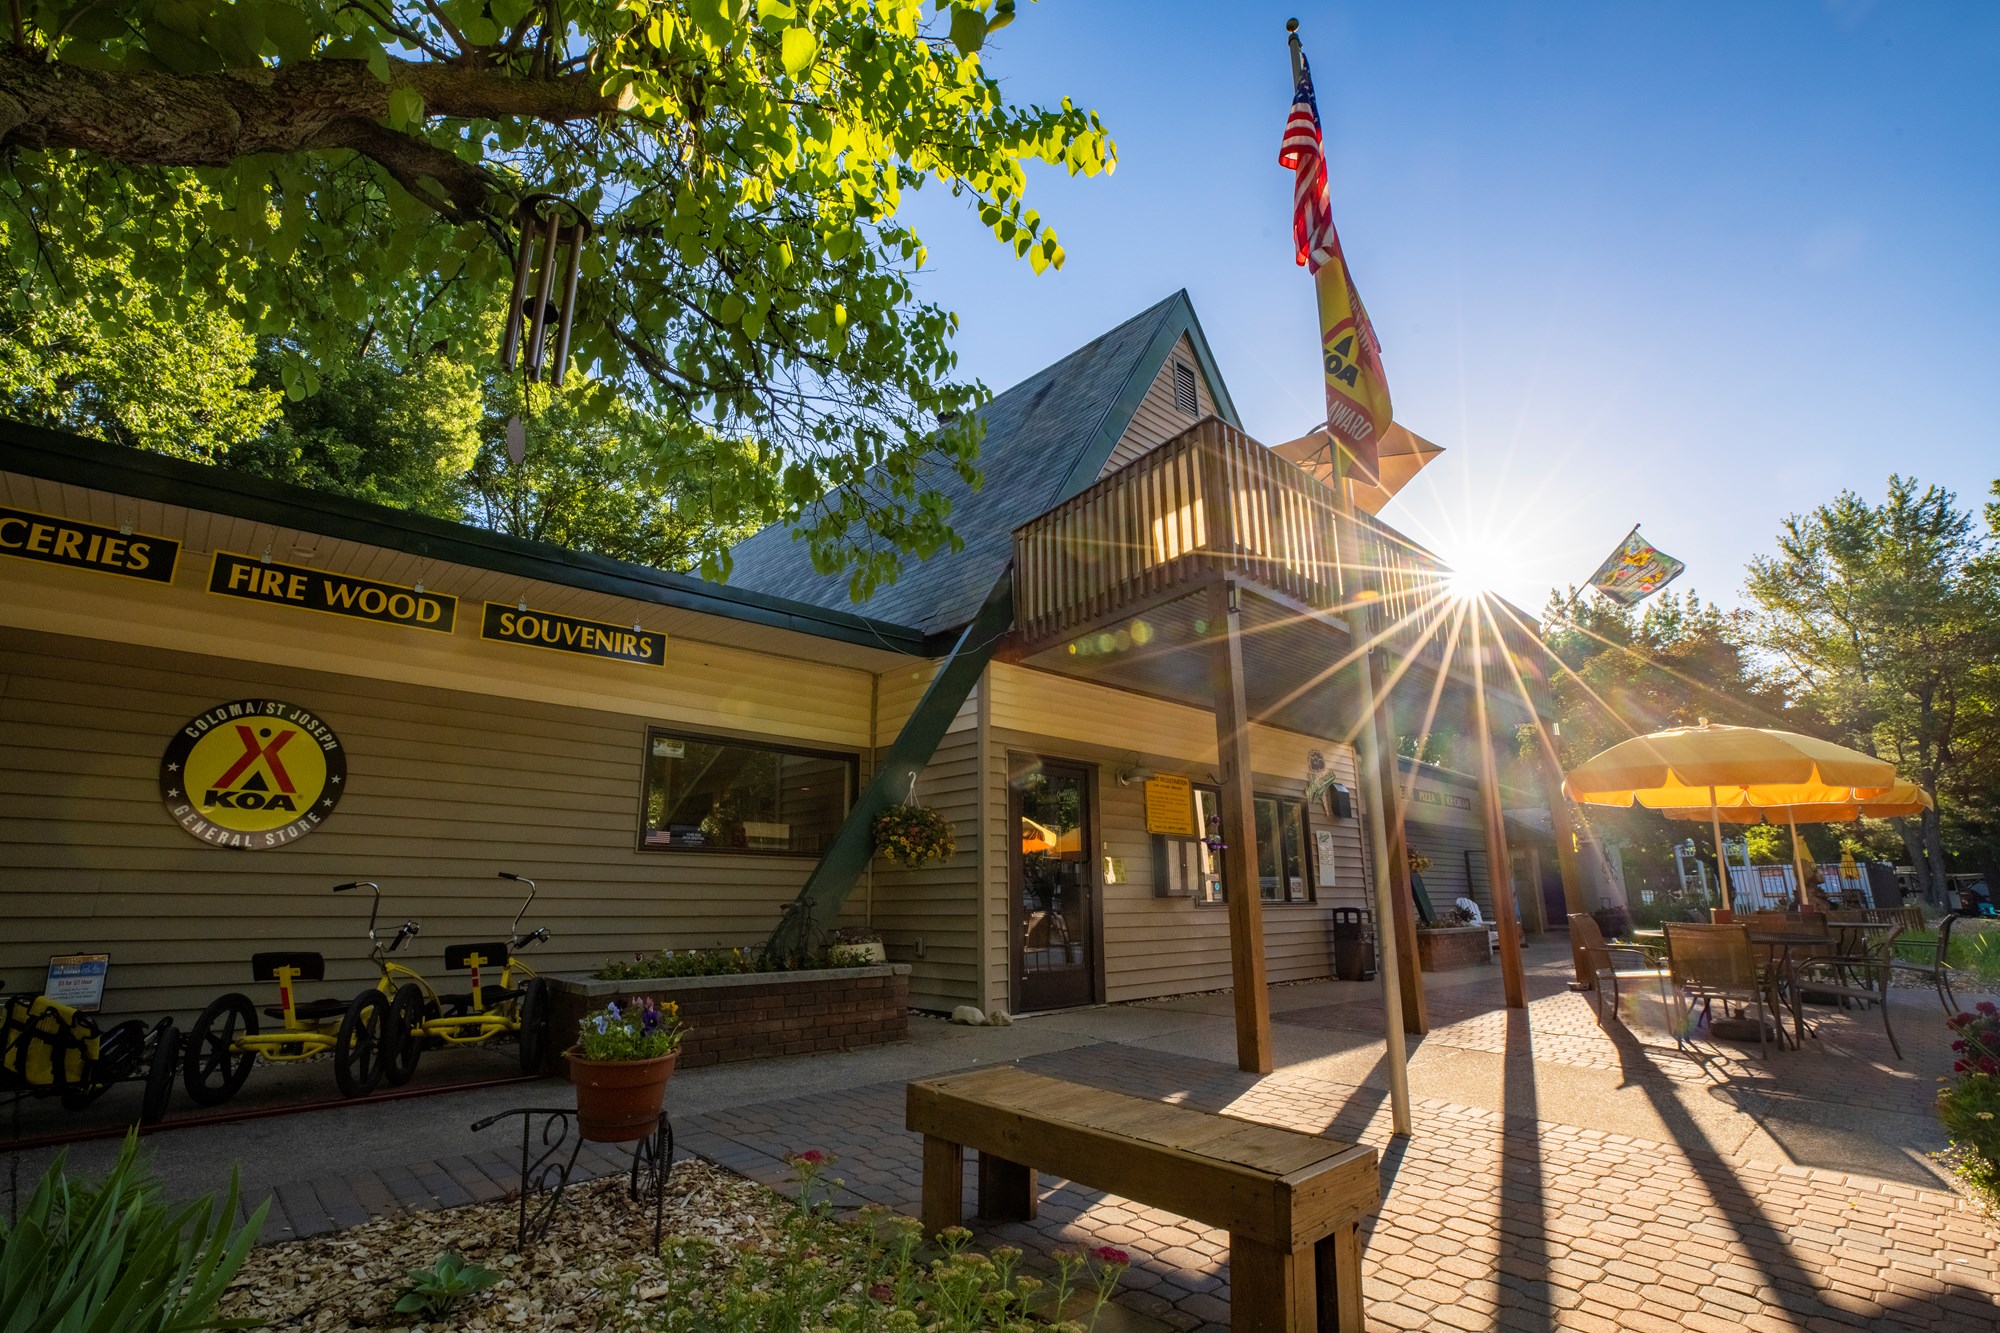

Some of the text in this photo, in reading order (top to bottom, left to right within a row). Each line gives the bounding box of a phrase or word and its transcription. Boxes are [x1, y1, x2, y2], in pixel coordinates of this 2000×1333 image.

[1323, 348, 1359, 388] OA
[1328, 400, 1373, 441] AWARD
[0, 517, 151, 570] CERIES
[228, 563, 441, 623] FIRE WOOD
[500, 612, 653, 658] SOUVENIRS
[290, 710, 338, 751] JOSEPH
[203, 789, 297, 812] KOA
[1419, 790, 1436, 804] PIZZA
[174, 804, 321, 847] GENERAL STORE
